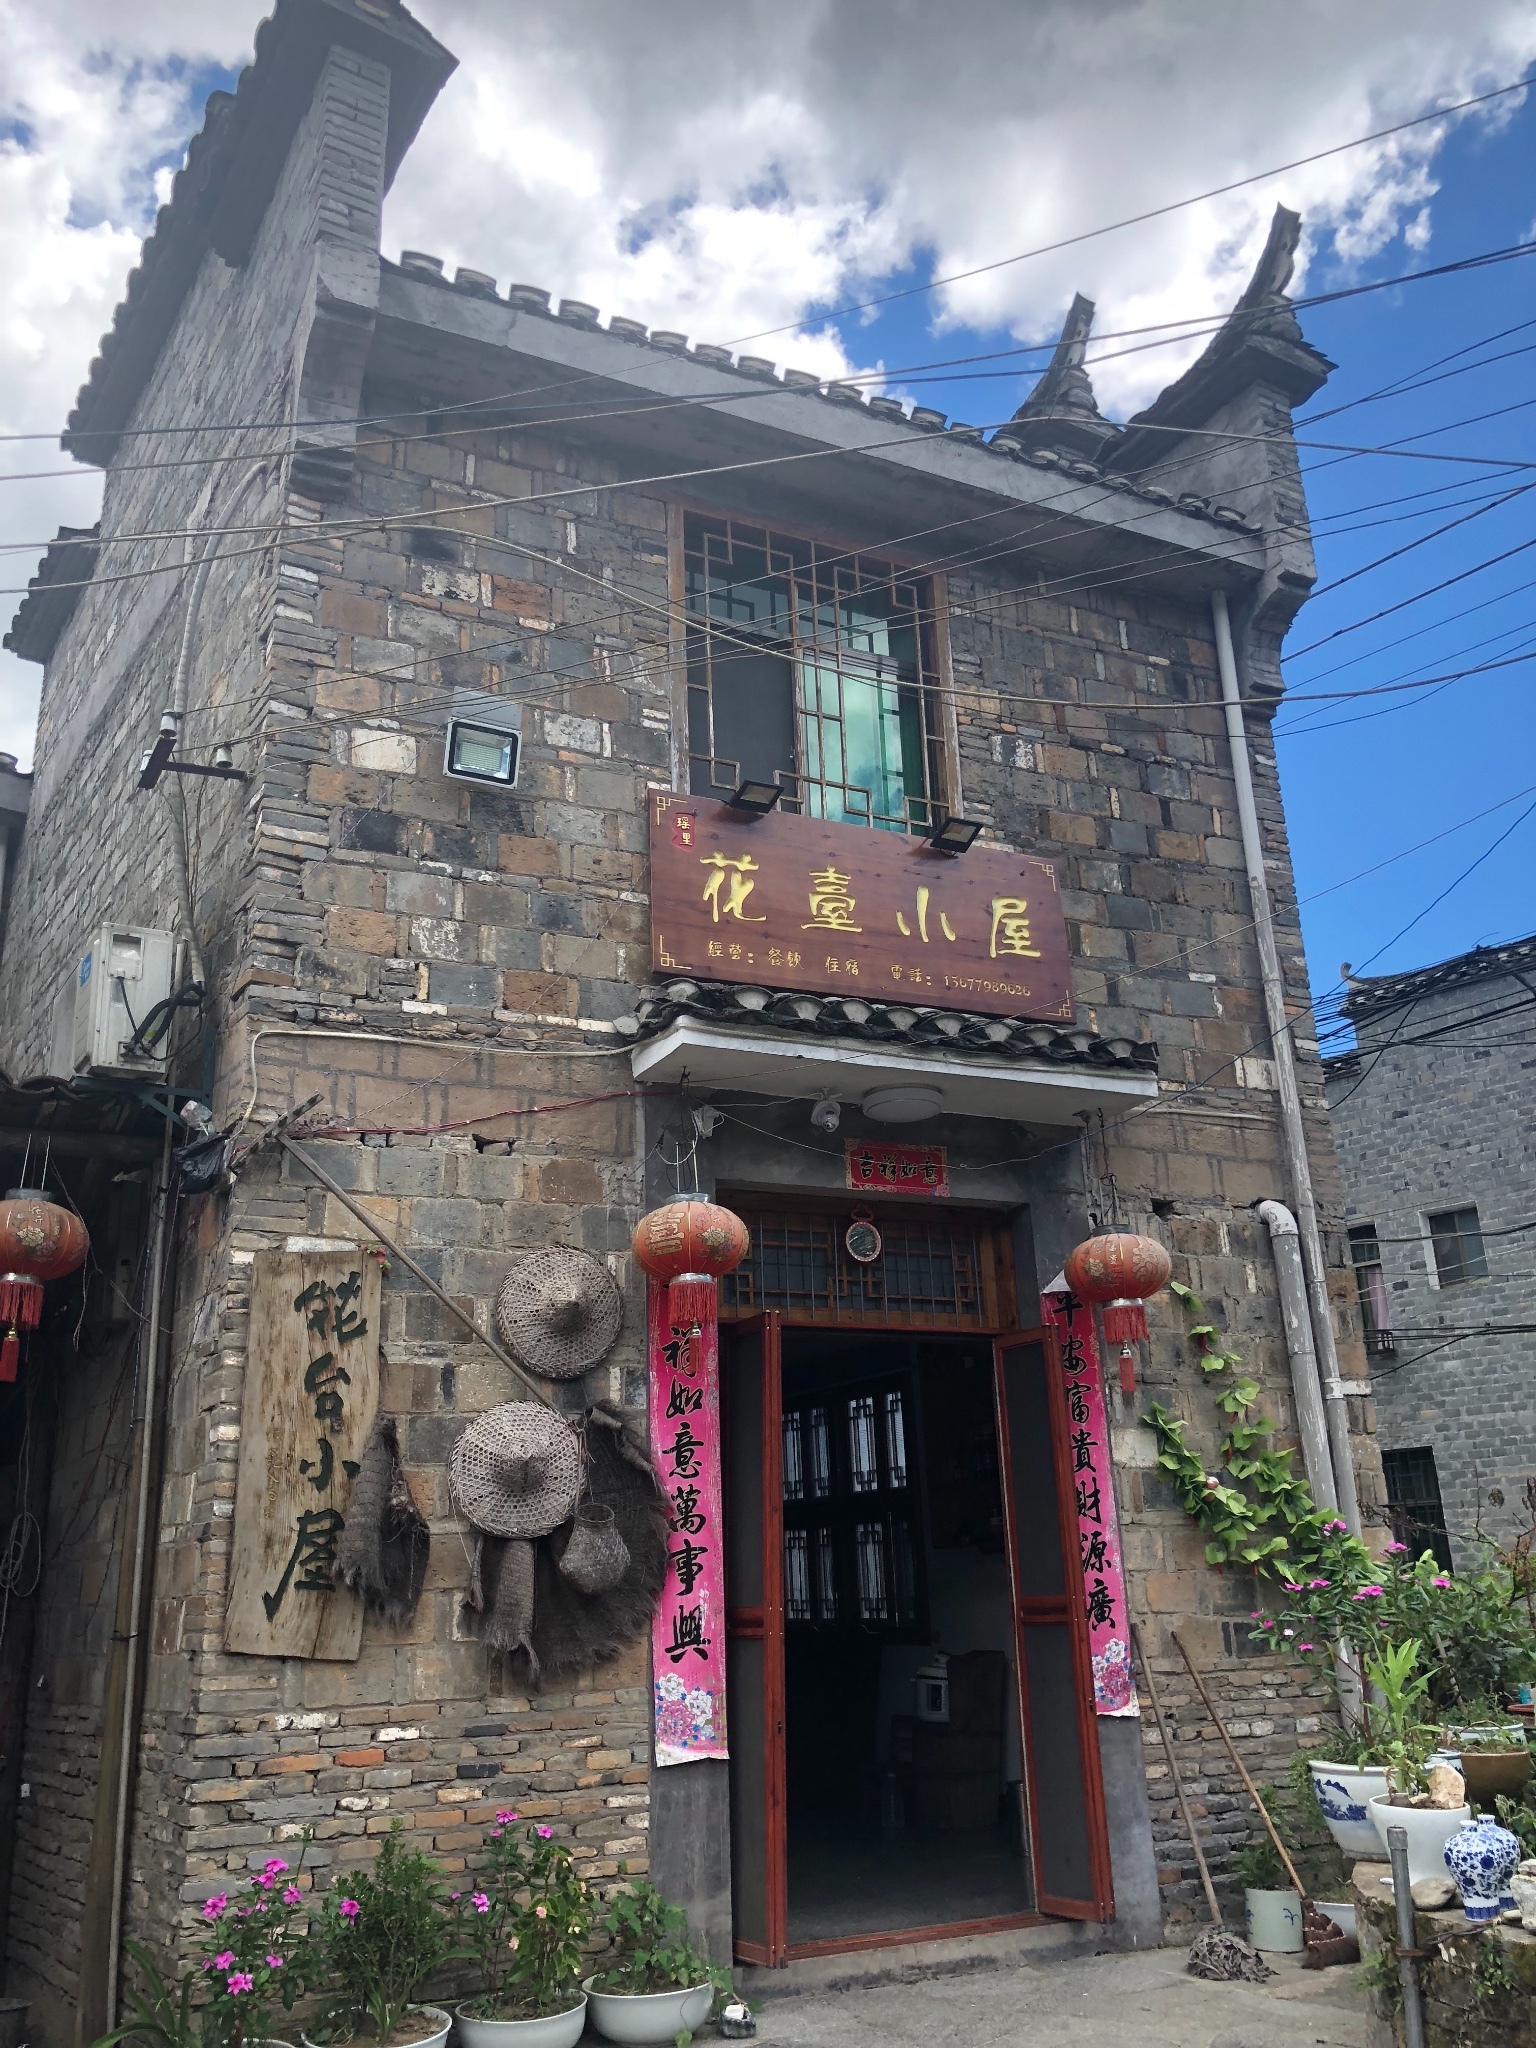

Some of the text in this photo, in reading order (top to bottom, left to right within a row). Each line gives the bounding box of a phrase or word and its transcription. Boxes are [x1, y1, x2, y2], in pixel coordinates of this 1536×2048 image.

[699, 850, 1041, 959] 花臺小屋
[859, 1150, 939, 1184] 吉祥如意
[261, 1271, 368, 1621] 花台小屋
[660, 1282, 711, 1664] 祥如意萬事興
